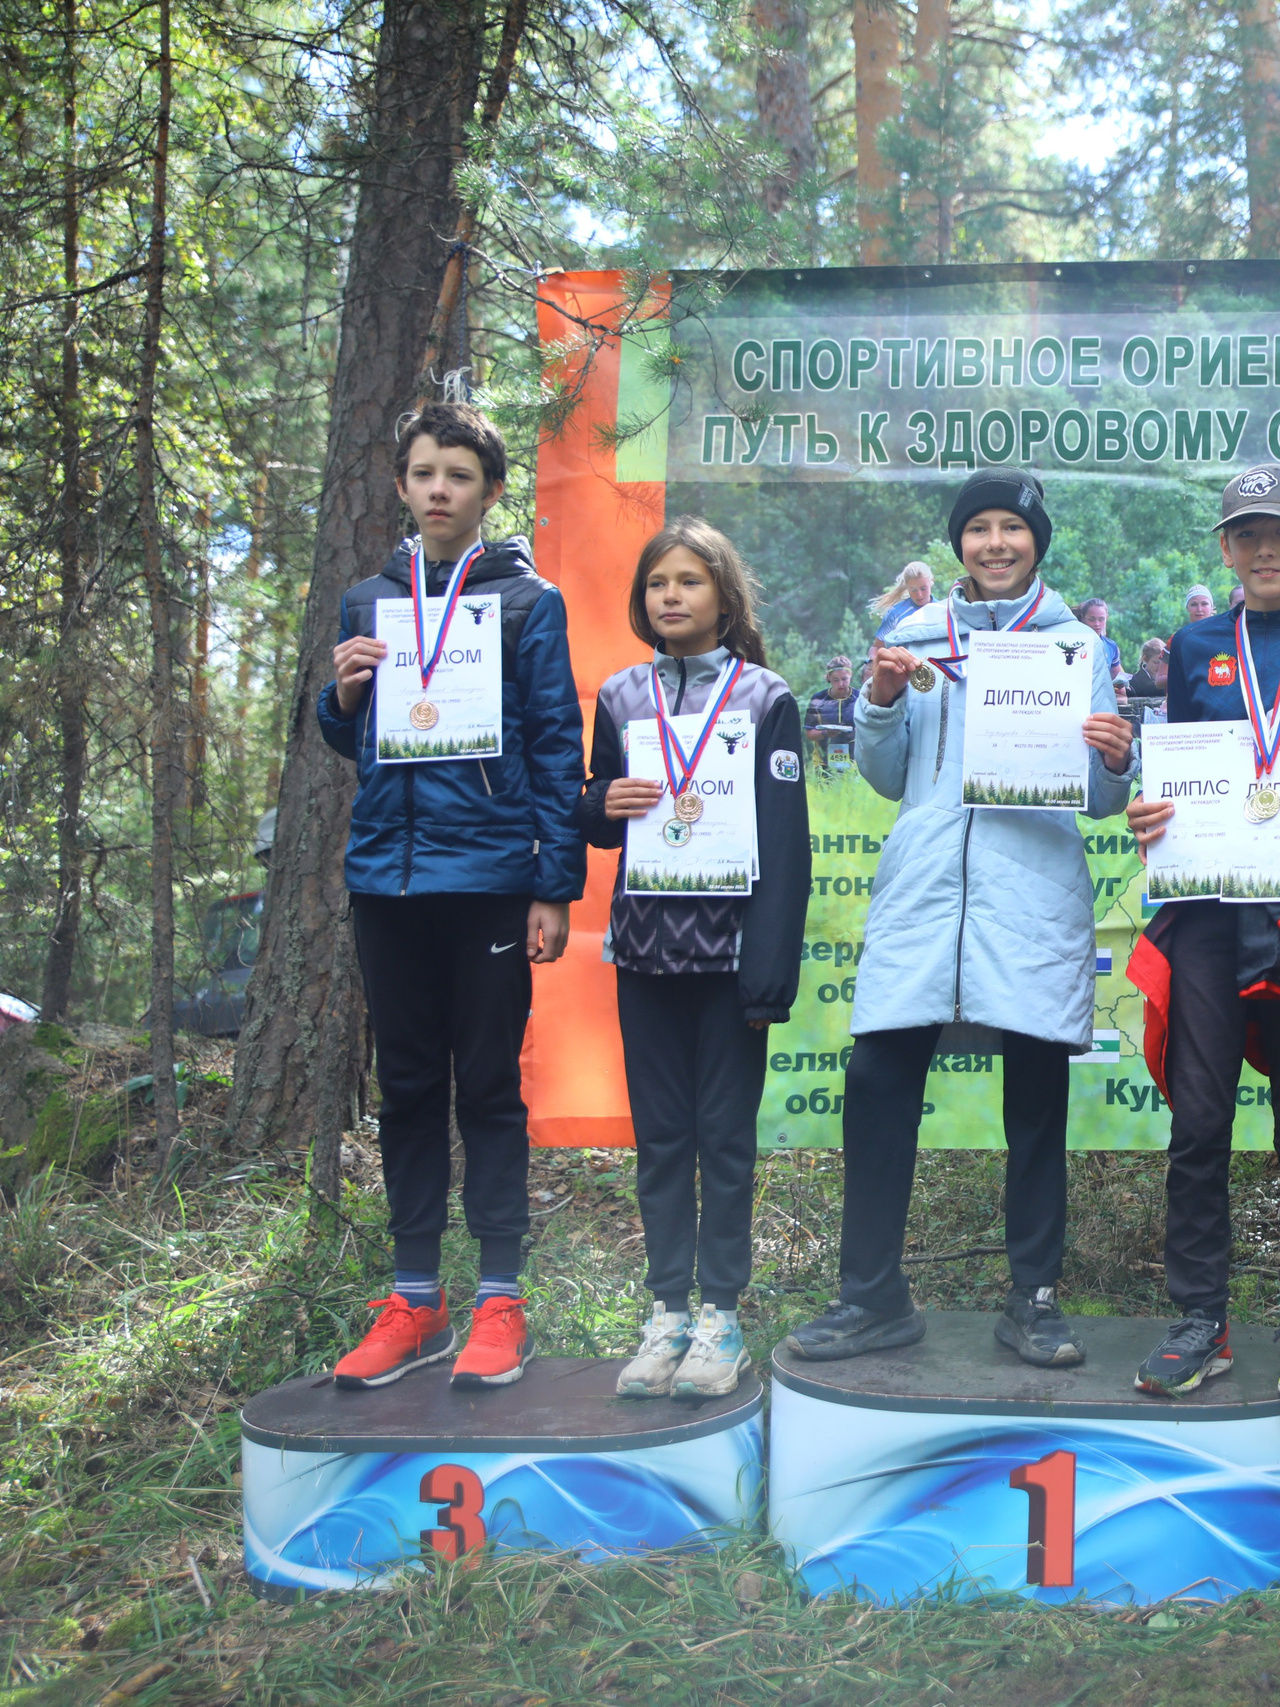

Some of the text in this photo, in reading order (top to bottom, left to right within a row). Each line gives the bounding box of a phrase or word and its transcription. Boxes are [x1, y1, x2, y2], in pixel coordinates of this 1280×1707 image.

[732, 335, 1102, 392] СПОРТИВНОЕ
[700, 412, 839, 464] ПУТЬ
[858, 411, 890, 464] К
[906, 409, 1249, 472] ЗДОРОВОМУ
[395, 649, 482, 667] ДИЛОМ
[984, 689, 1071, 707] ДИПЛОМ
[419, 1463, 487, 1575] 3
[1009, 1448, 1077, 1588] 1
